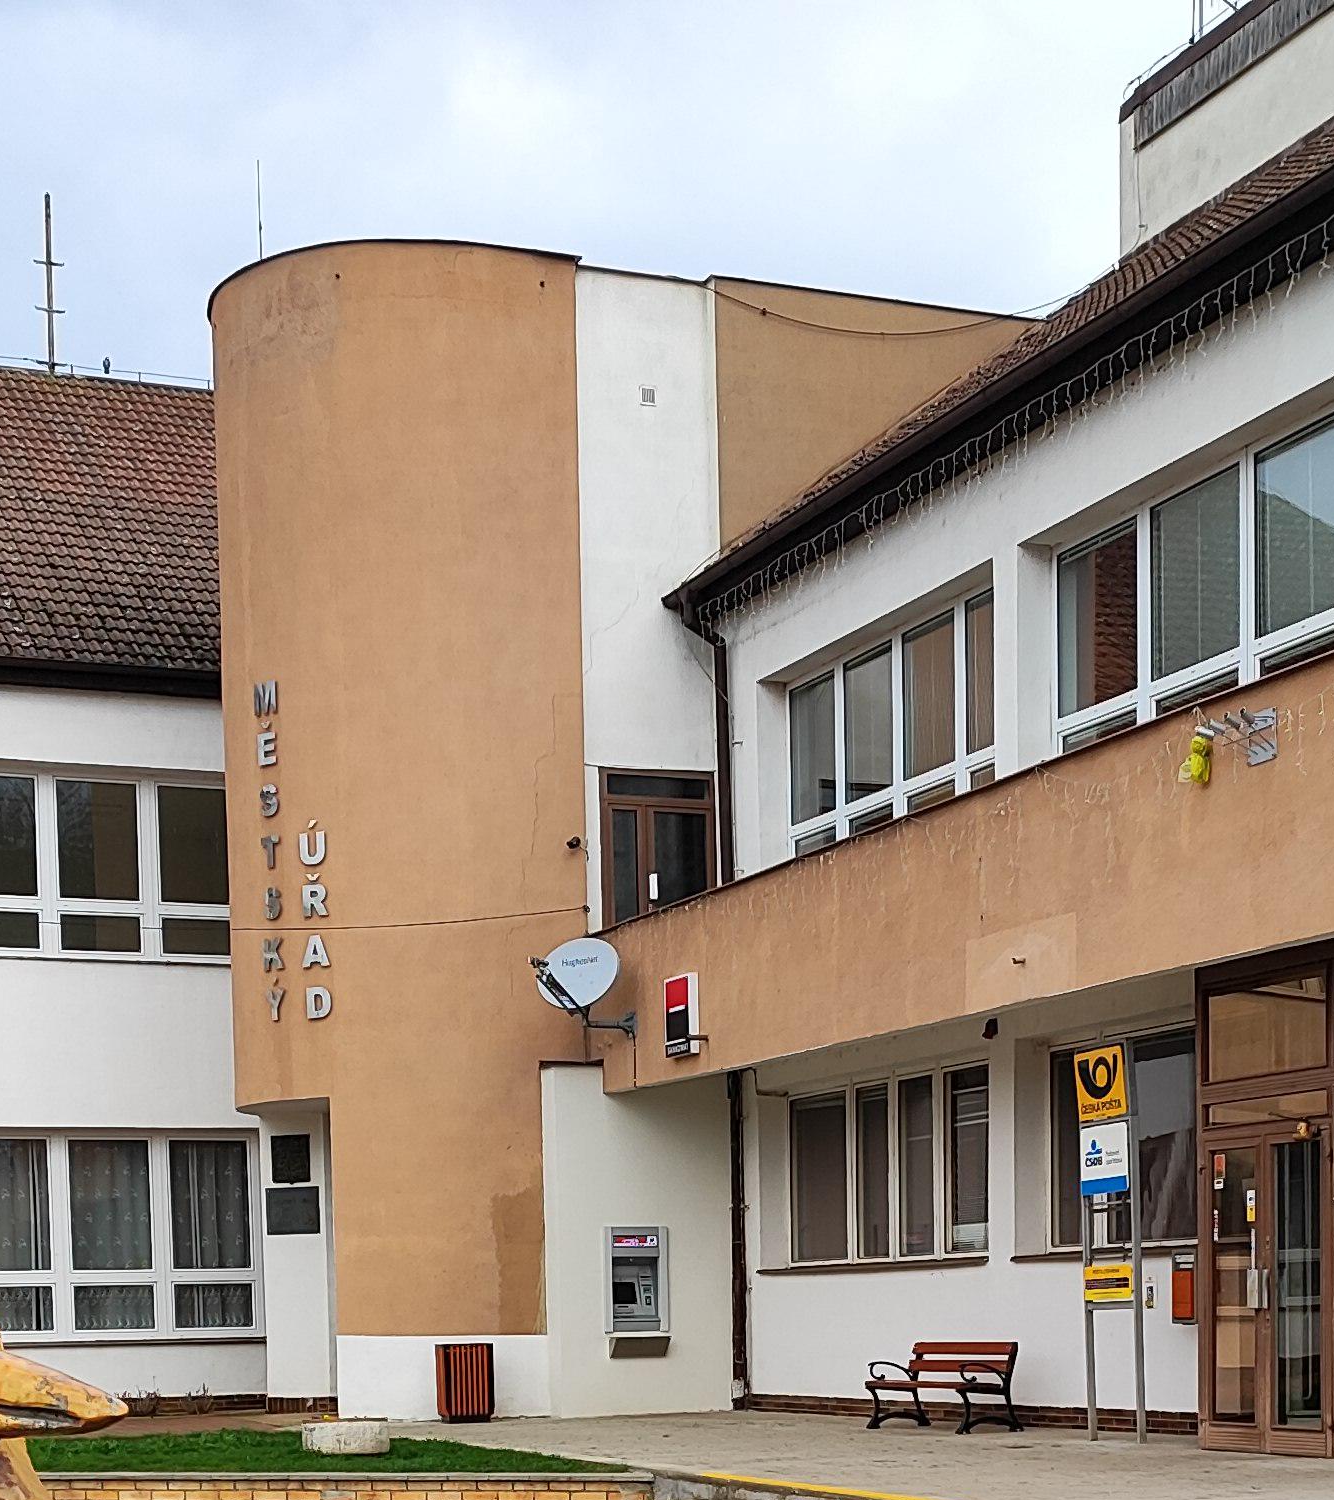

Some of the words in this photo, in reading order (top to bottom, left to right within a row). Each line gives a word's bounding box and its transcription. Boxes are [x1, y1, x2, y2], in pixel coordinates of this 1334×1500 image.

[253, 679, 285, 1022] MĚSTSKÝ
[298, 818, 333, 1020] ÚŘAD
[1081, 1101, 1101, 1115] ČESKÁ
[1101, 1098, 1121, 1111] POŠTA
